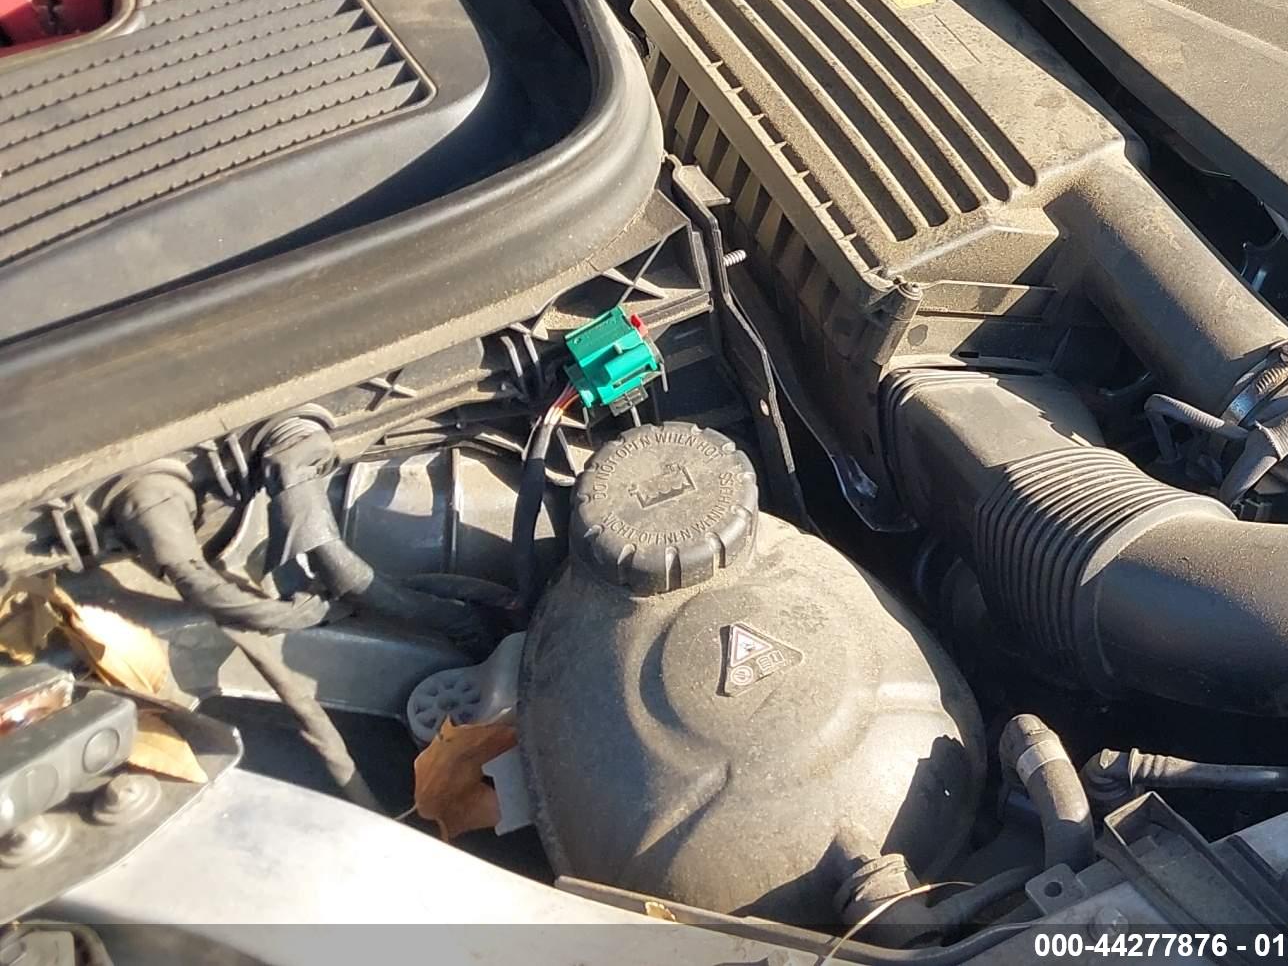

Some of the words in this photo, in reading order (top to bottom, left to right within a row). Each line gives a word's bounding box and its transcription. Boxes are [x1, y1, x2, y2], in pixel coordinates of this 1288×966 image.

[595, 457, 618, 481] NOT
[654, 433, 697, 447] WHEN
[696, 441, 725, 465] HOT
